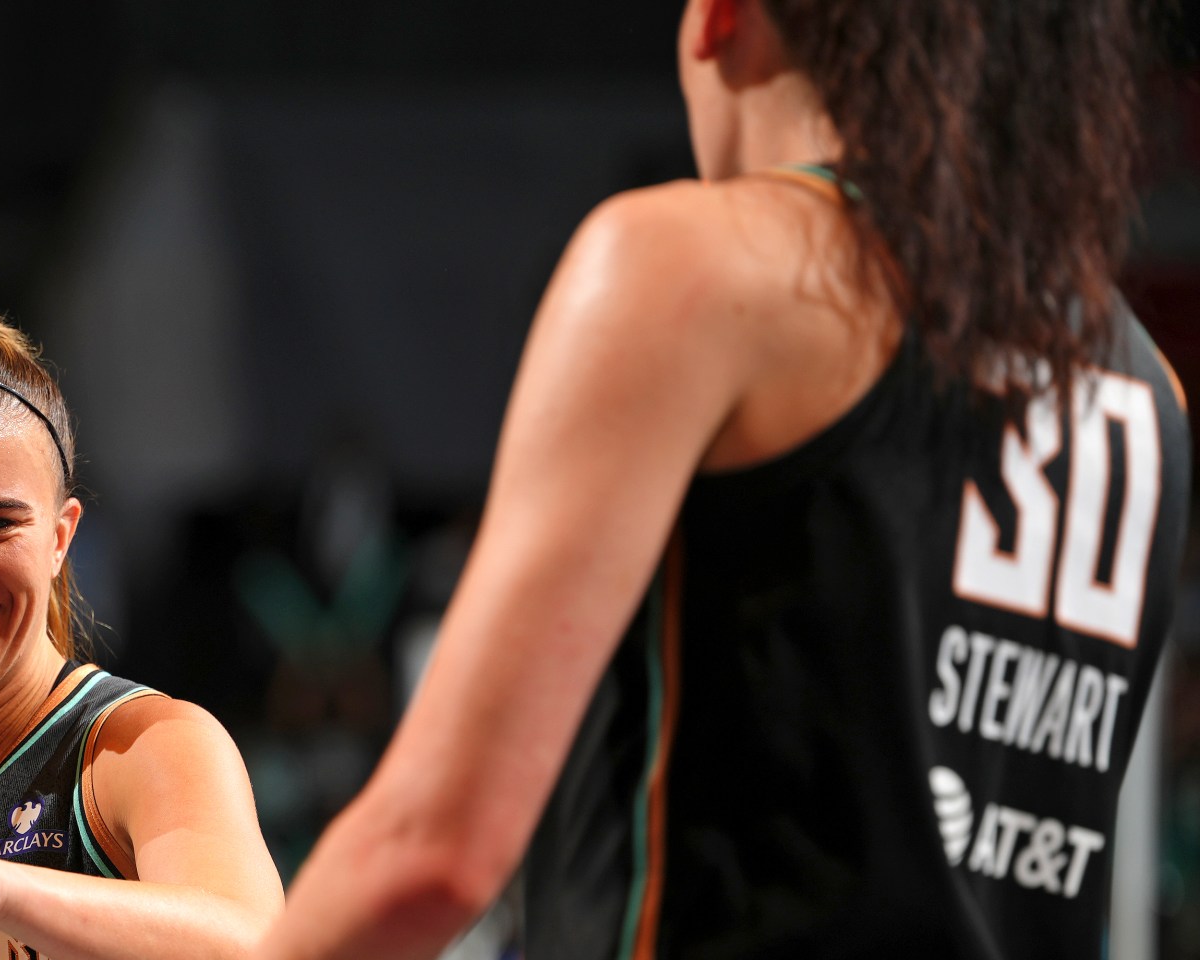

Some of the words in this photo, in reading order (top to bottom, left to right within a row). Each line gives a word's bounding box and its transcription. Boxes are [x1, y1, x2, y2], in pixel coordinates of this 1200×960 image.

[953, 350, 1161, 650] 30
[928, 624, 1128, 773] STEWART
[968, 802, 1105, 899] AT&T
